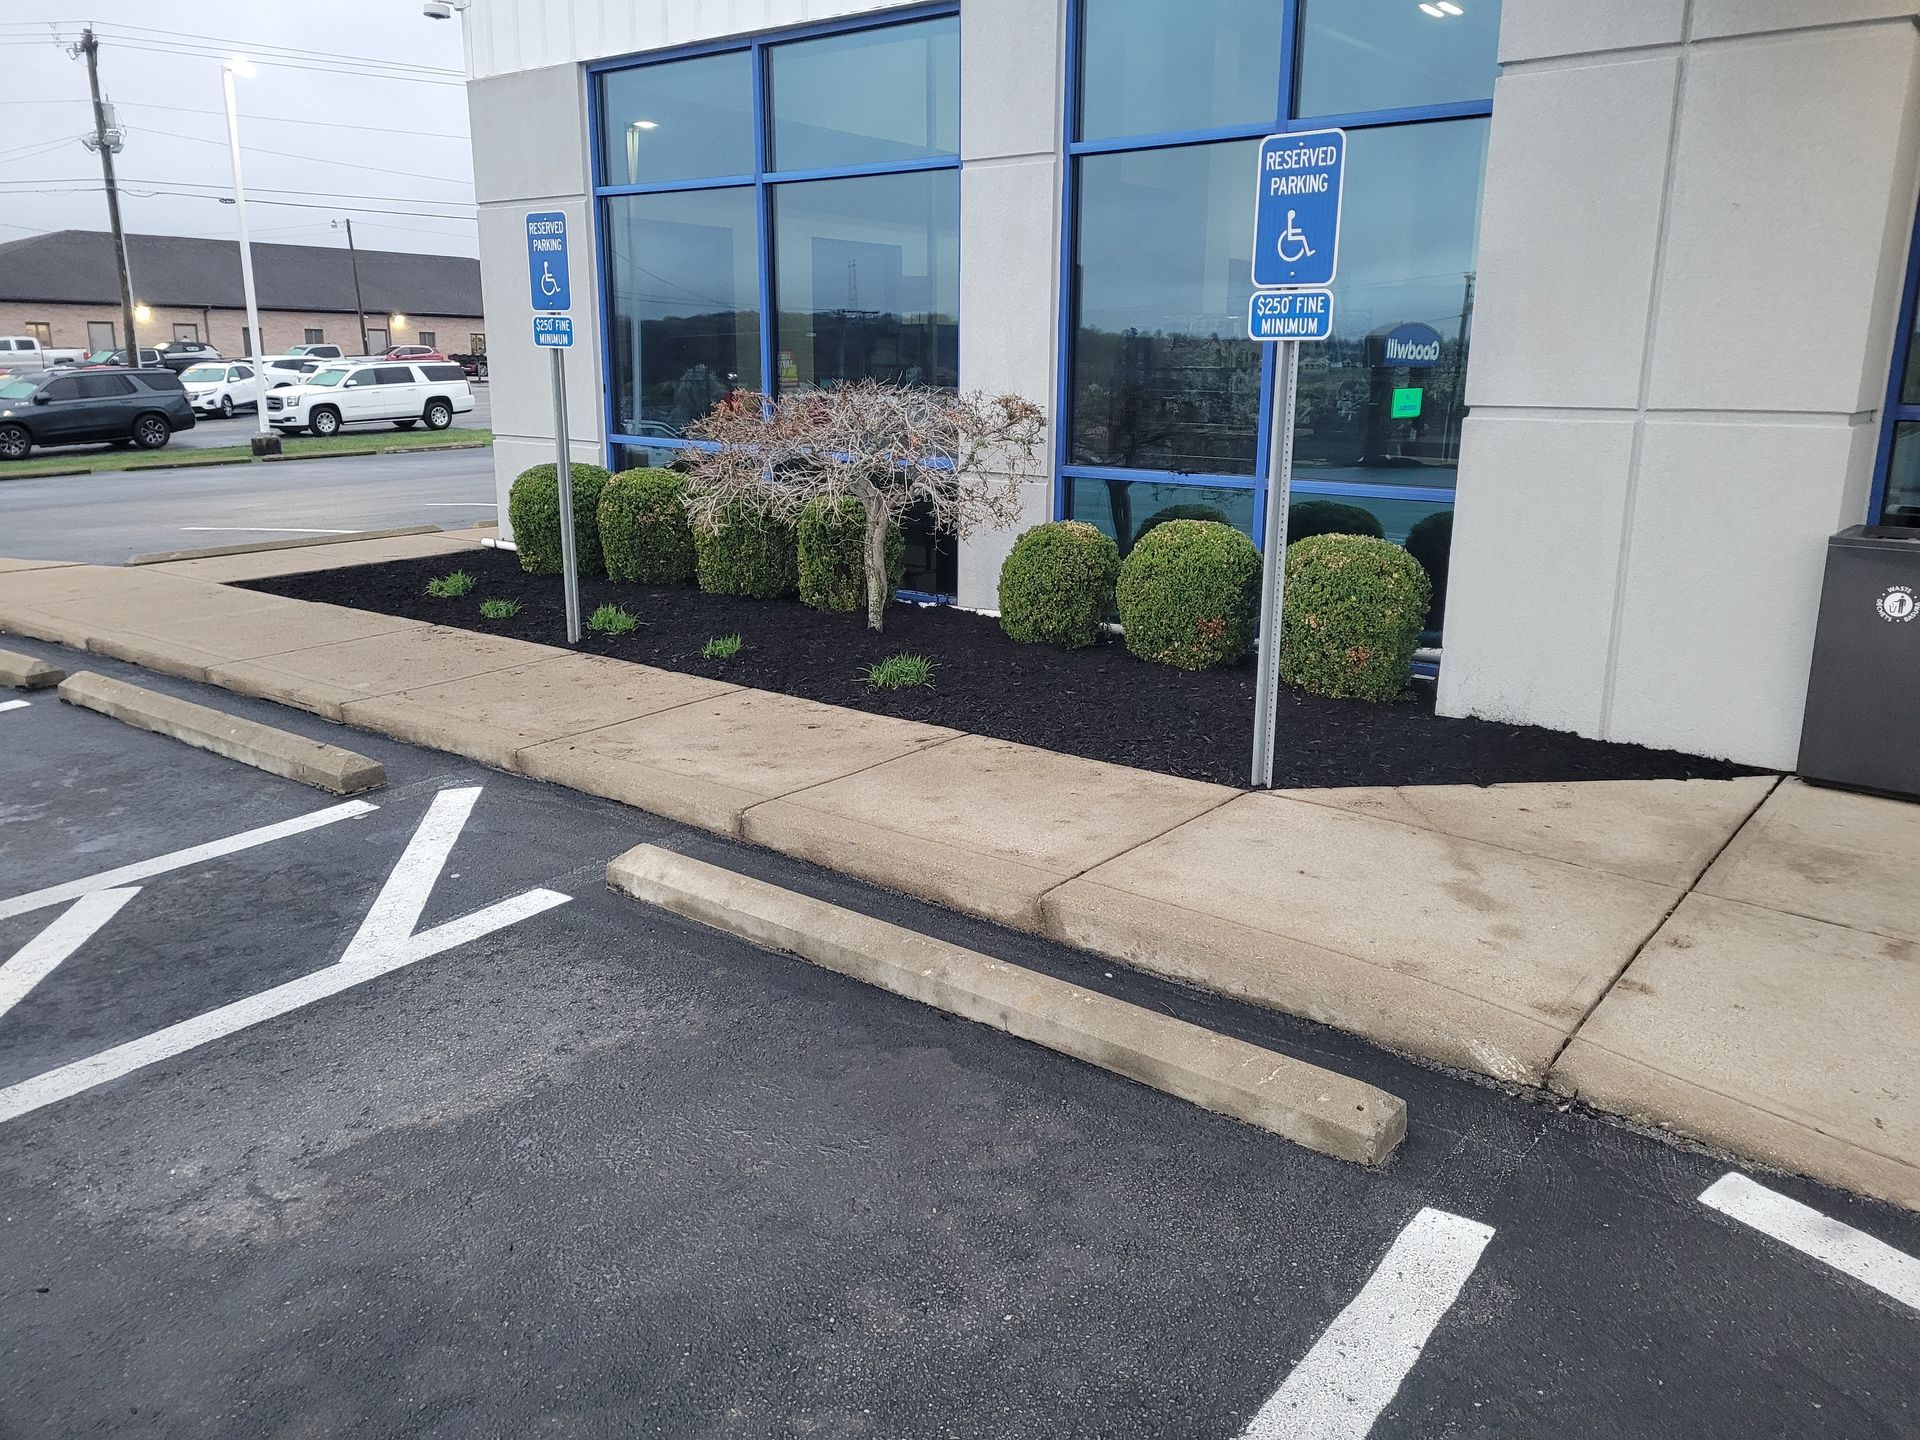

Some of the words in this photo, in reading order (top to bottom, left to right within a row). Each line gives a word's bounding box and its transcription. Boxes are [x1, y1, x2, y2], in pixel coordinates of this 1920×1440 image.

[1266, 146, 1336, 170] RESERVED
[1270, 174, 1329, 196] PARKING
[529, 221, 563, 234] RESERVED
[533, 238, 562, 252] PARKING
[1257, 296, 1290, 316] $250
[1296, 296, 1325, 314] FINE
[555, 320, 570, 331] FINE
[1261, 317, 1318, 334] MINIMUM
[539, 333, 569, 345] MINIMUM
